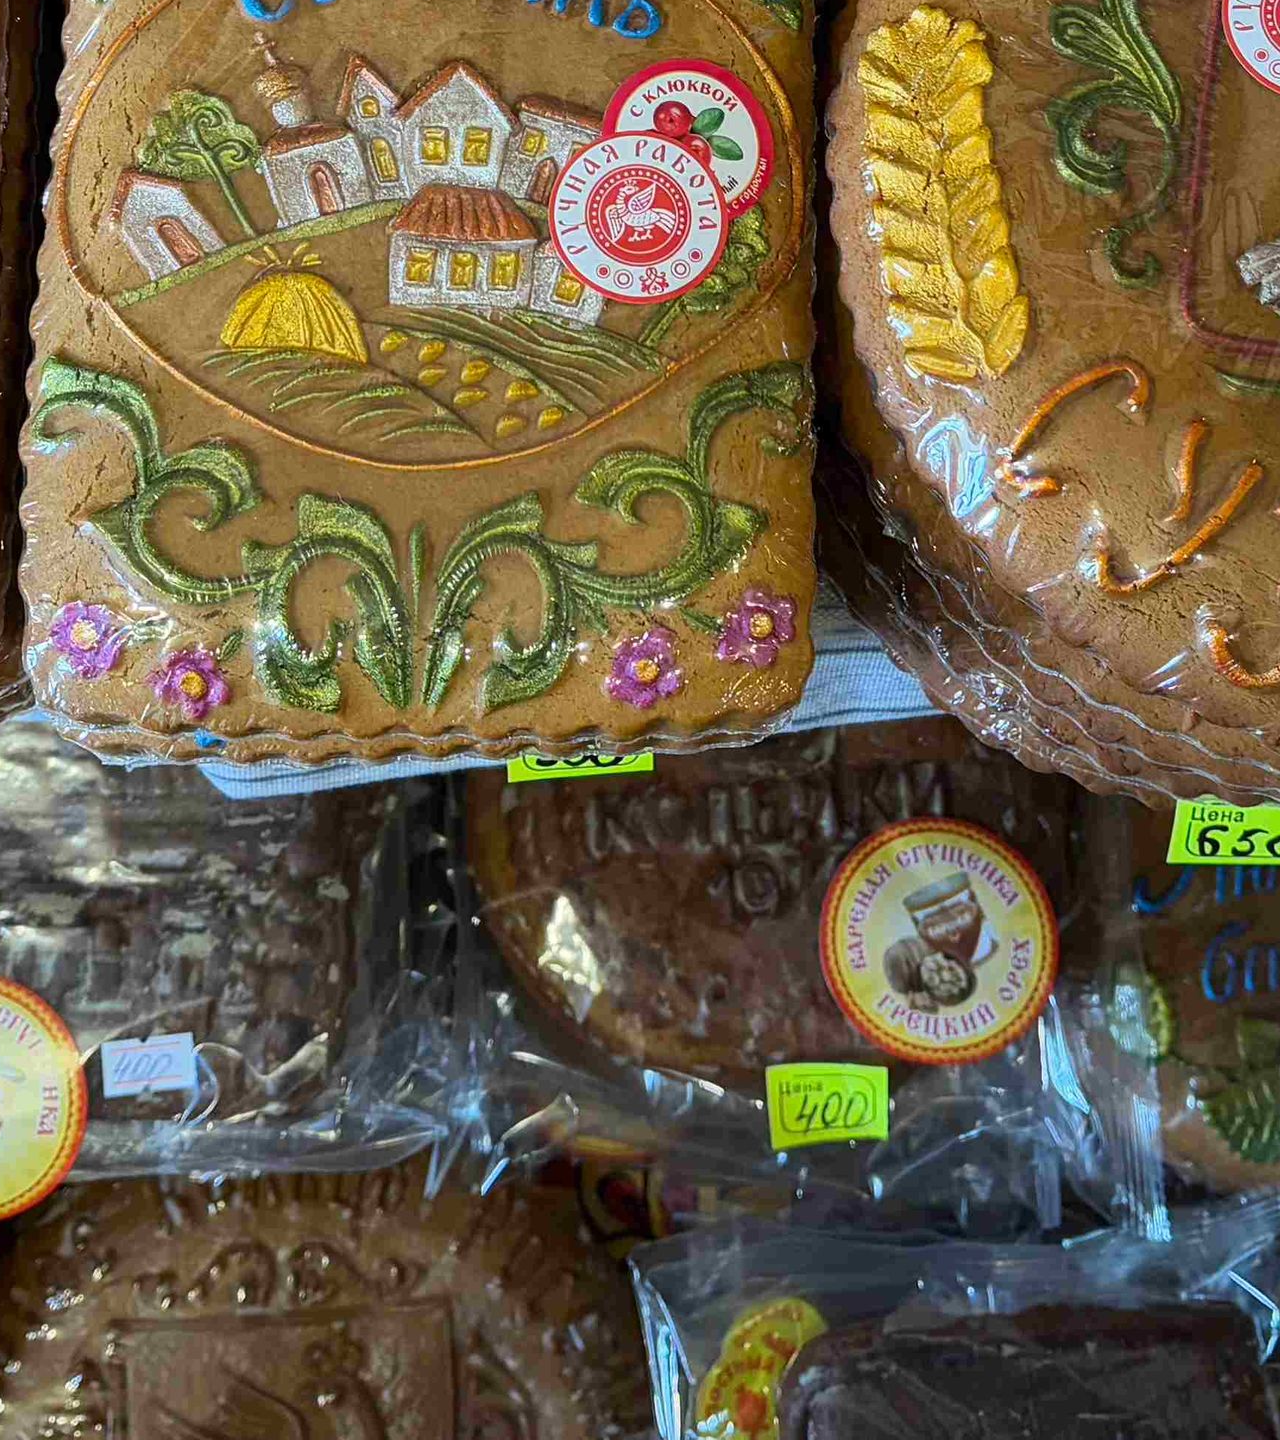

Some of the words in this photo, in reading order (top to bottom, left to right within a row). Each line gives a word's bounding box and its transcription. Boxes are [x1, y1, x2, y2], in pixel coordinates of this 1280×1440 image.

[558, 144, 620, 255] РУЧНАЯ
[635, 139, 719, 231] РАБОТА
[1190, 806, 1246, 824] Цена
[999, 936, 1032, 1002] ОРЕХ
[795, 1093, 874, 1130] 400
